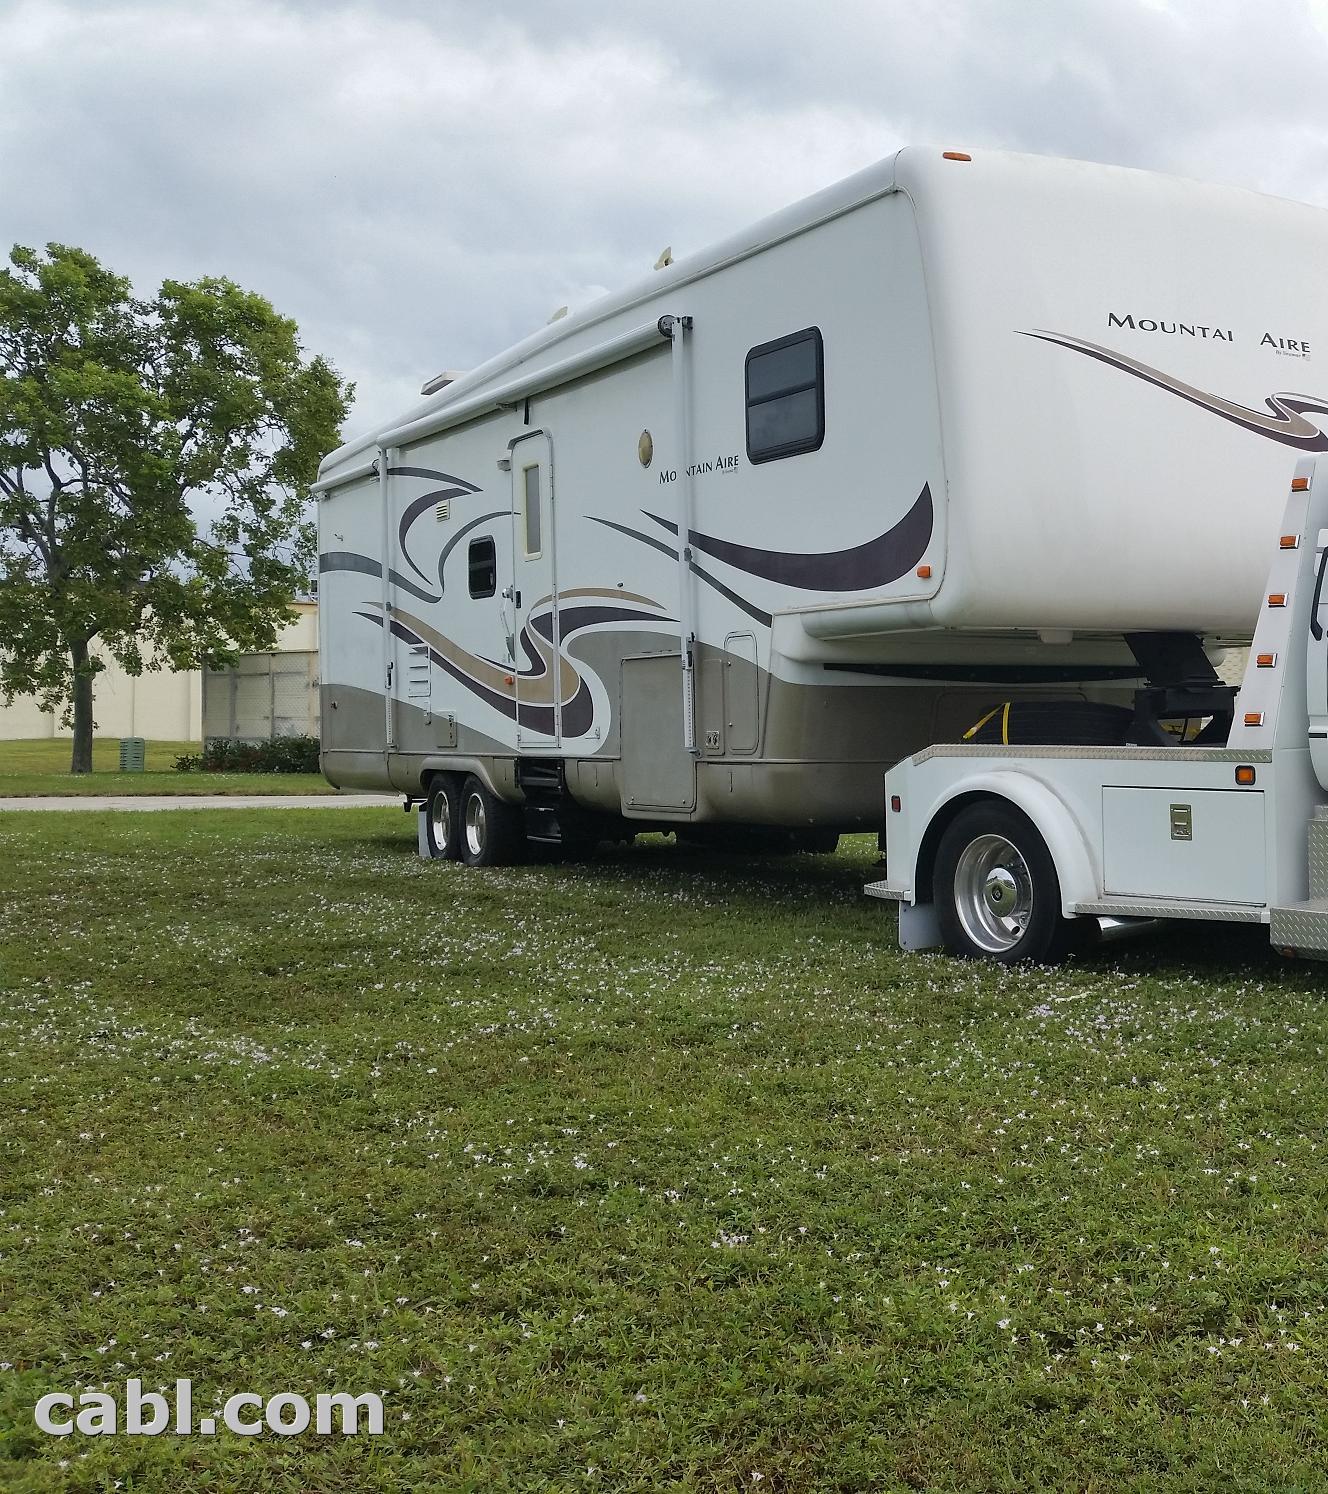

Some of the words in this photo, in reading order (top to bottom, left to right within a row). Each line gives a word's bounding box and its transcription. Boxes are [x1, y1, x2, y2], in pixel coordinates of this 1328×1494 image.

[1260, 332, 1311, 352] AIRE
[659, 461, 713, 484] MONTAIN
[715, 455, 739, 470] AIRE
